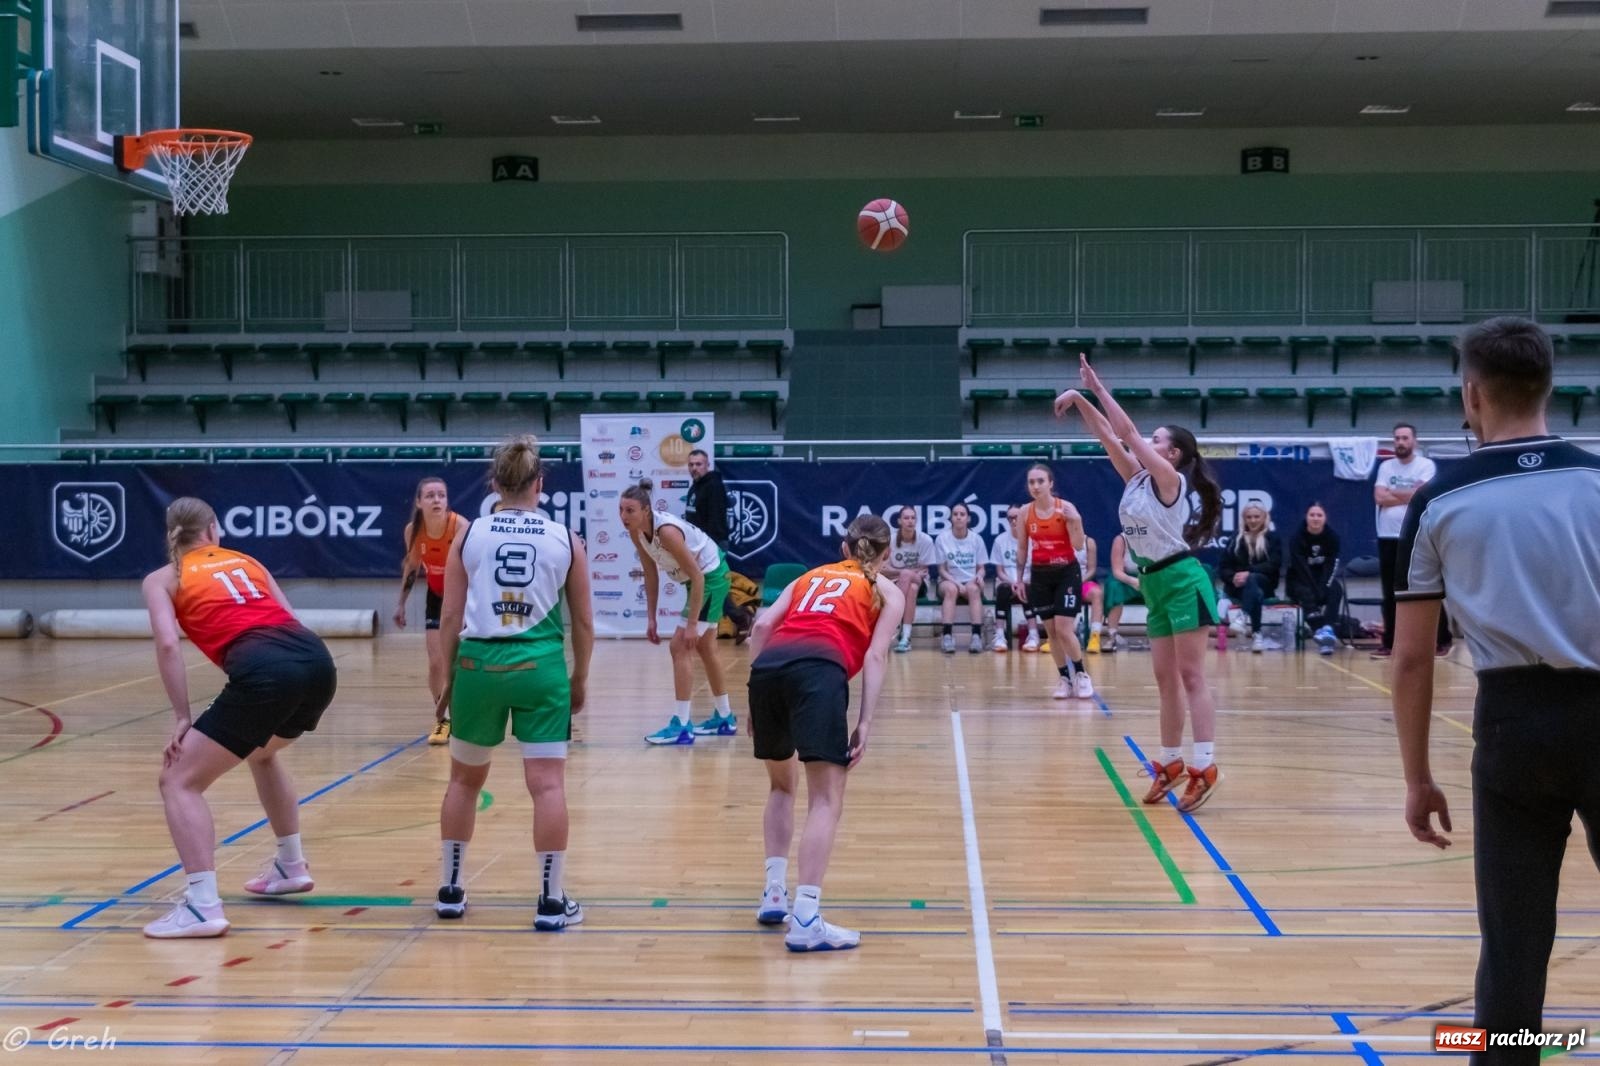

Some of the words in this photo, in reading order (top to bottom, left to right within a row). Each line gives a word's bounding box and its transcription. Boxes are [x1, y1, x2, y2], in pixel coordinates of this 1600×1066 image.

[1247, 156, 1262, 170] B
[496, 164, 508, 178] A
[516, 164, 534, 178] A
[217, 494, 383, 537] CIBÓRZ
[490, 525, 545, 535] RACIBÓRZ
[494, 542, 536, 588] 3
[212, 567, 264, 604] 11
[796, 576, 851, 614] 12
[1063, 594, 1076, 608] 13
[495, 602, 530, 614] SEGET
